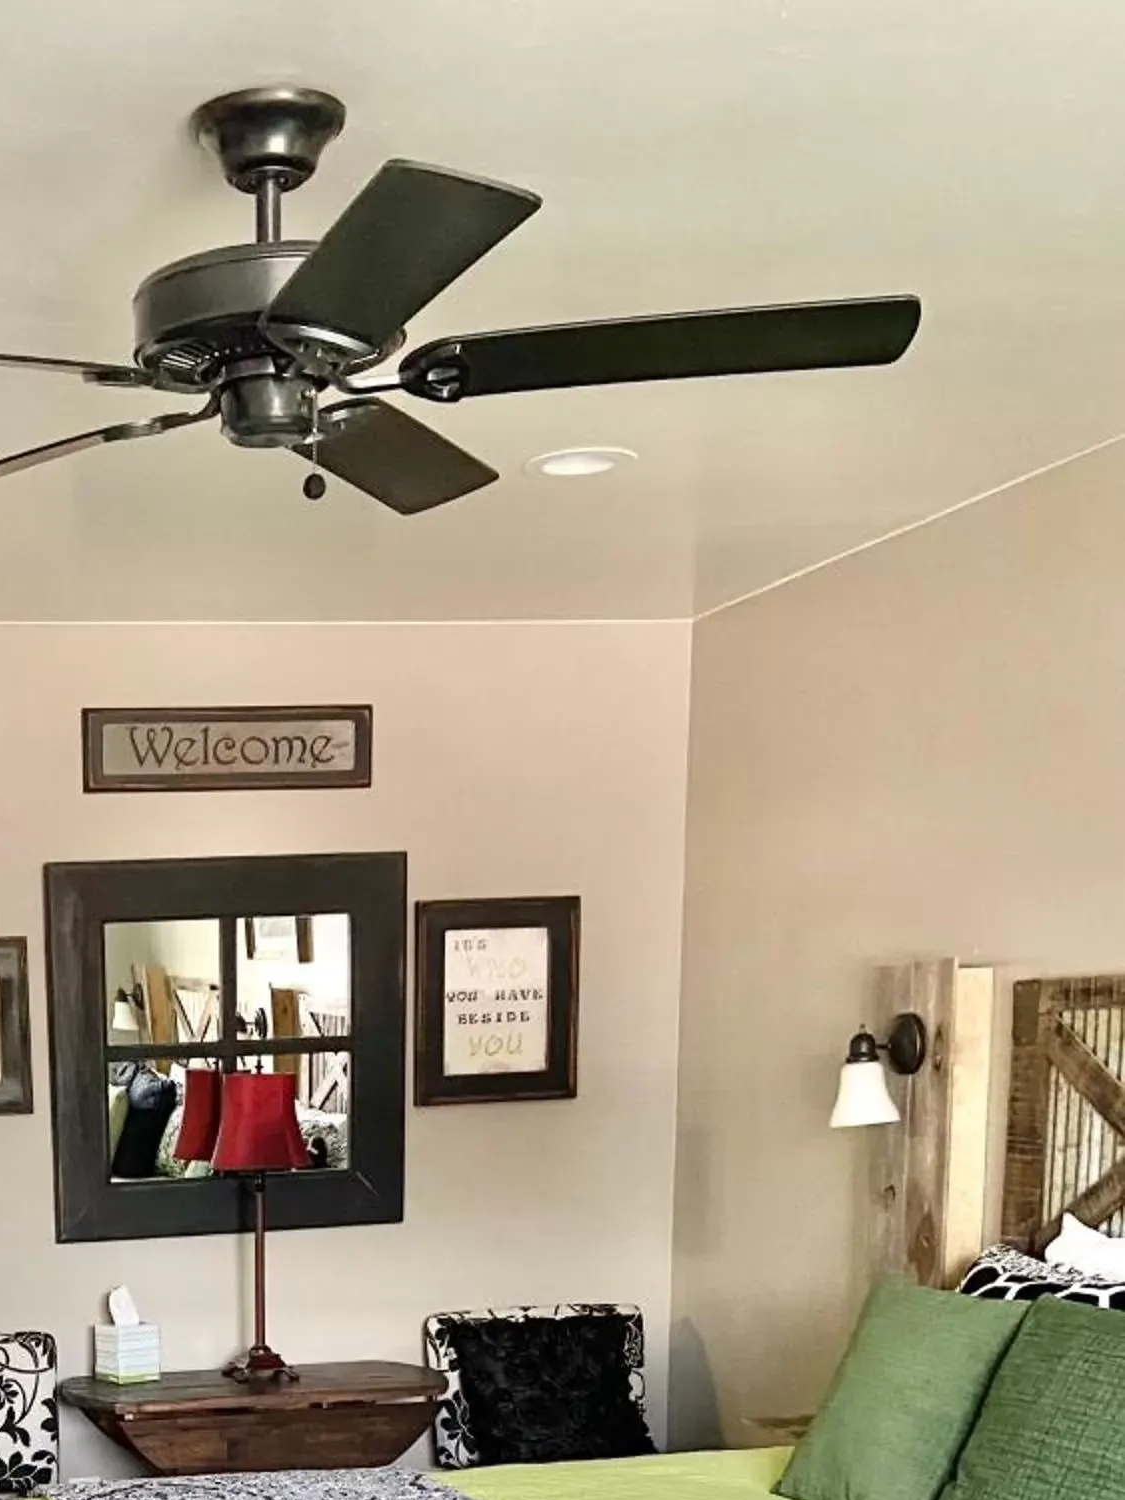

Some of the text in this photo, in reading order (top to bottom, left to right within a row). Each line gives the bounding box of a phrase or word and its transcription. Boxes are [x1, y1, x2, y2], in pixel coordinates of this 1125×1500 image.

[129, 726, 335, 770] Welcome
[446, 988, 544, 1003] YOU HAVE
[457, 1011, 531, 1025] BESIDE
[468, 1032, 524, 1057] YOU
